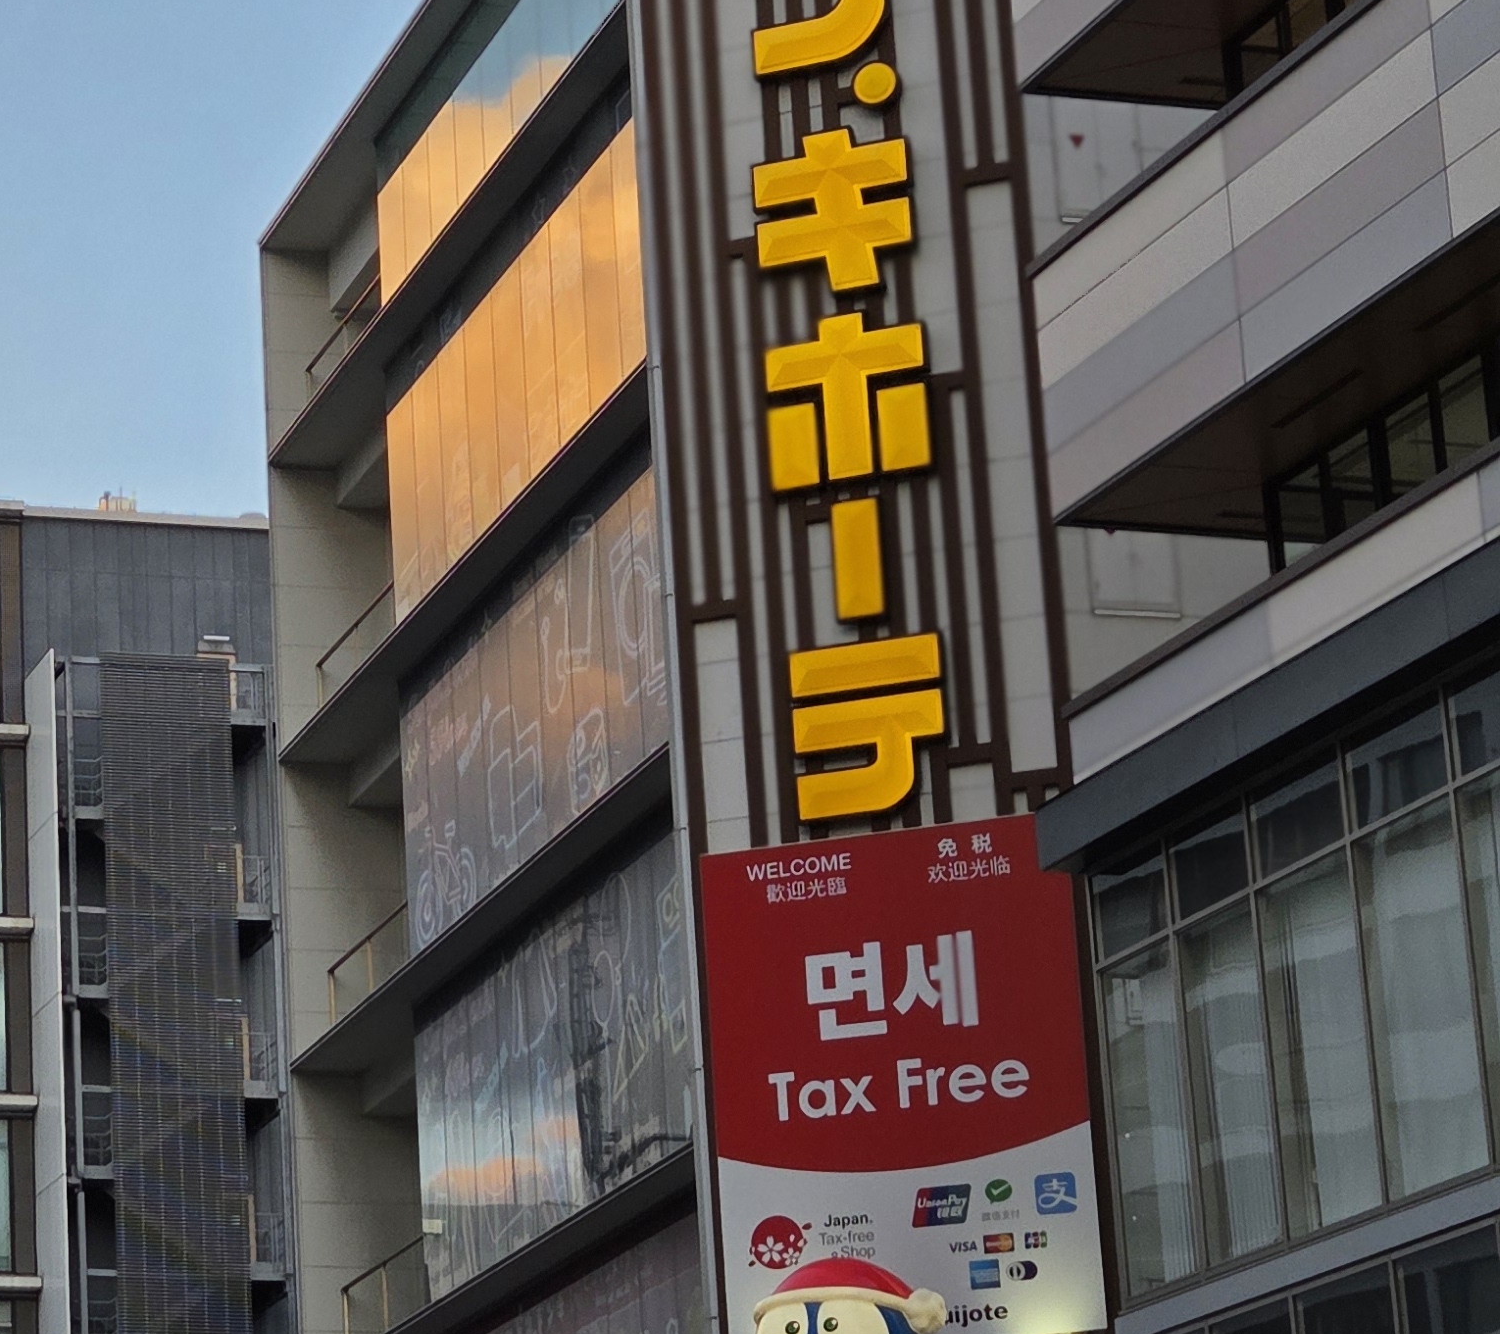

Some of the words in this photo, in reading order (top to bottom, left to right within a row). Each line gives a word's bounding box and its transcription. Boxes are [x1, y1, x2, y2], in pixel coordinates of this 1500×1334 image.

[746, 853, 852, 882] WELCOME
[927, 855, 1011, 883] 欢迎光临
[804, 930, 979, 1041] 면세
[769, 1070, 877, 1122] Tax
[896, 1058, 1030, 1109] Free
[818, 1230, 874, 1246] Tax-free
[949, 1241, 978, 1253] VISA
[840, 1245, 876, 1259] Shop
[945, 1303, 1008, 1328] uijote
